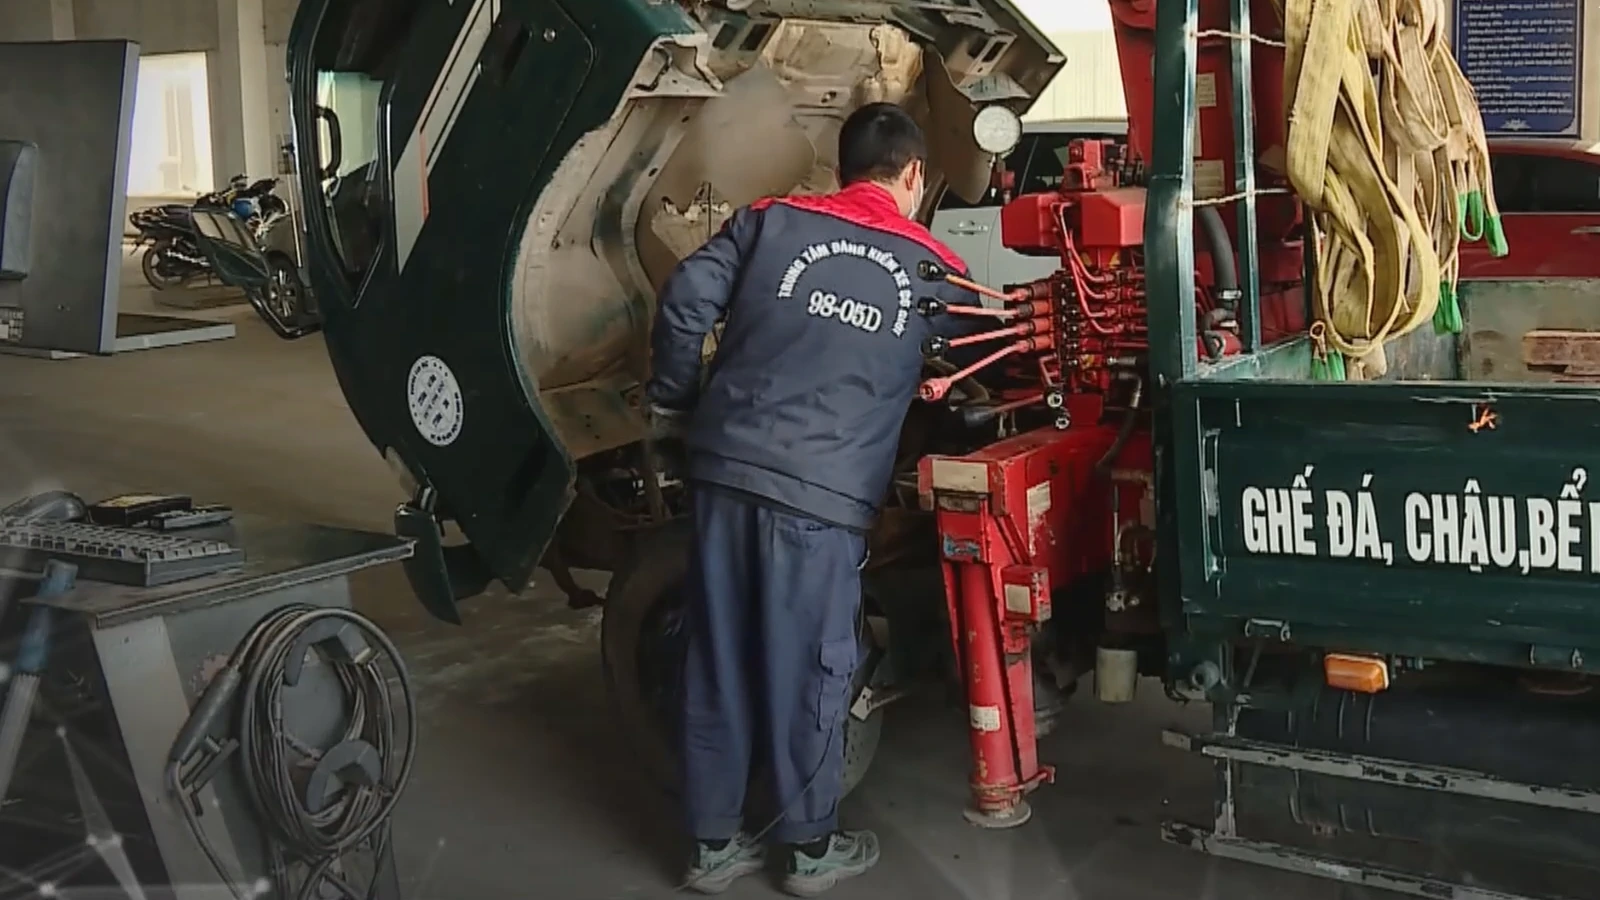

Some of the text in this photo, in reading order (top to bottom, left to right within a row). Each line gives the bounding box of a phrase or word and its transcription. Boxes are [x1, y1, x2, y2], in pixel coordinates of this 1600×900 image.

[808, 290, 882, 332] 98-05D
[1242, 465, 1317, 556] GHẾ
[1326, 474, 1393, 565] ĐÁ,
